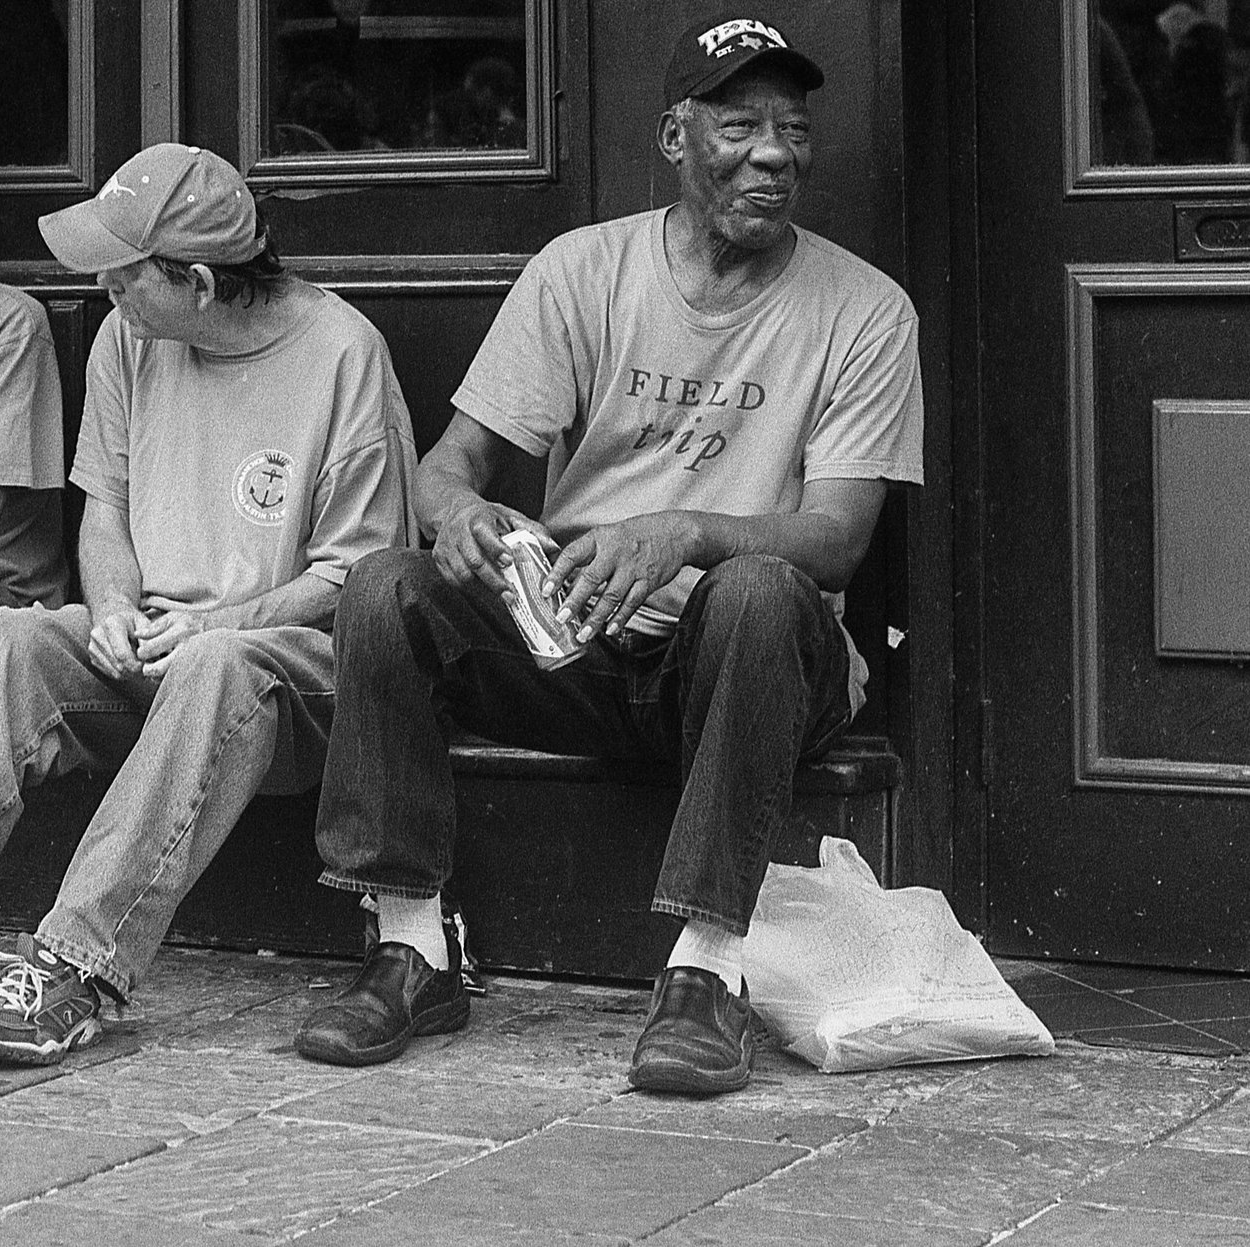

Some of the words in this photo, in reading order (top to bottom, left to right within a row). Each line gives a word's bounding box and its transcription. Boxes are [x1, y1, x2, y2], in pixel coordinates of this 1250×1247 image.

[697, 18, 787, 56] TEXAS
[626, 368, 766, 411] FIELD
[632, 416, 728, 473] trip
